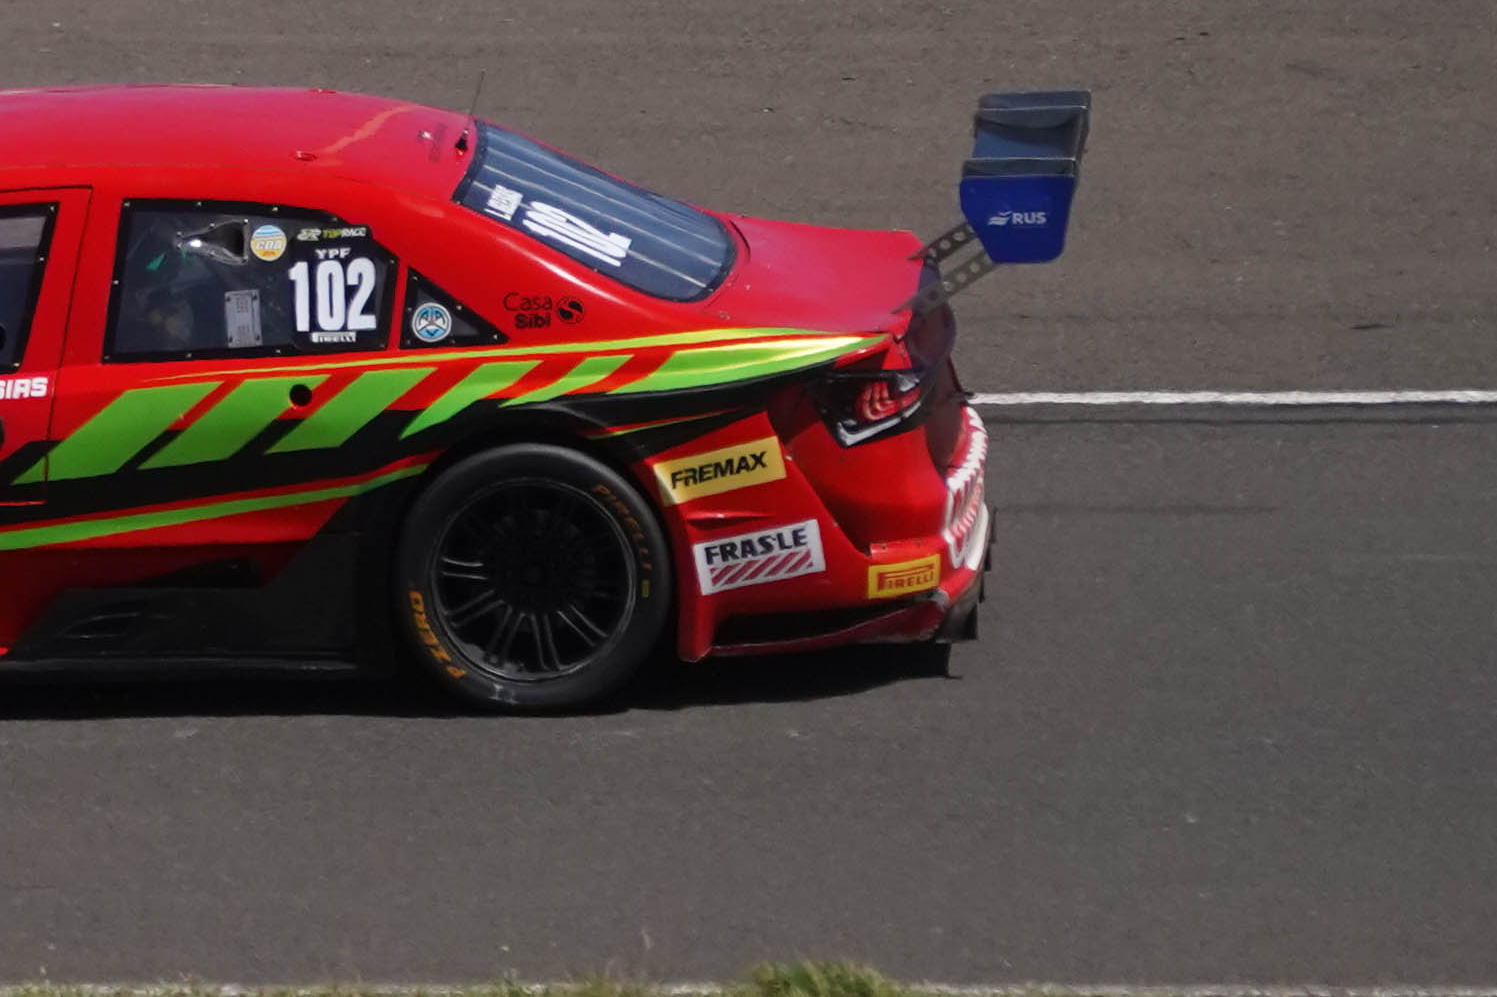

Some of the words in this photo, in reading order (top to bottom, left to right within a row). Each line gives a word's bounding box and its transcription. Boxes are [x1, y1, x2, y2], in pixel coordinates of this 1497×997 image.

[1012, 211, 1047, 225] RUS
[315, 247, 351, 259] YPF
[288, 257, 377, 332] 102
[503, 292, 553, 312] Casa
[514, 312, 552, 330] Sibi
[670, 449, 769, 490] FREMAX
[877, 563, 937, 593] PIRELLI
